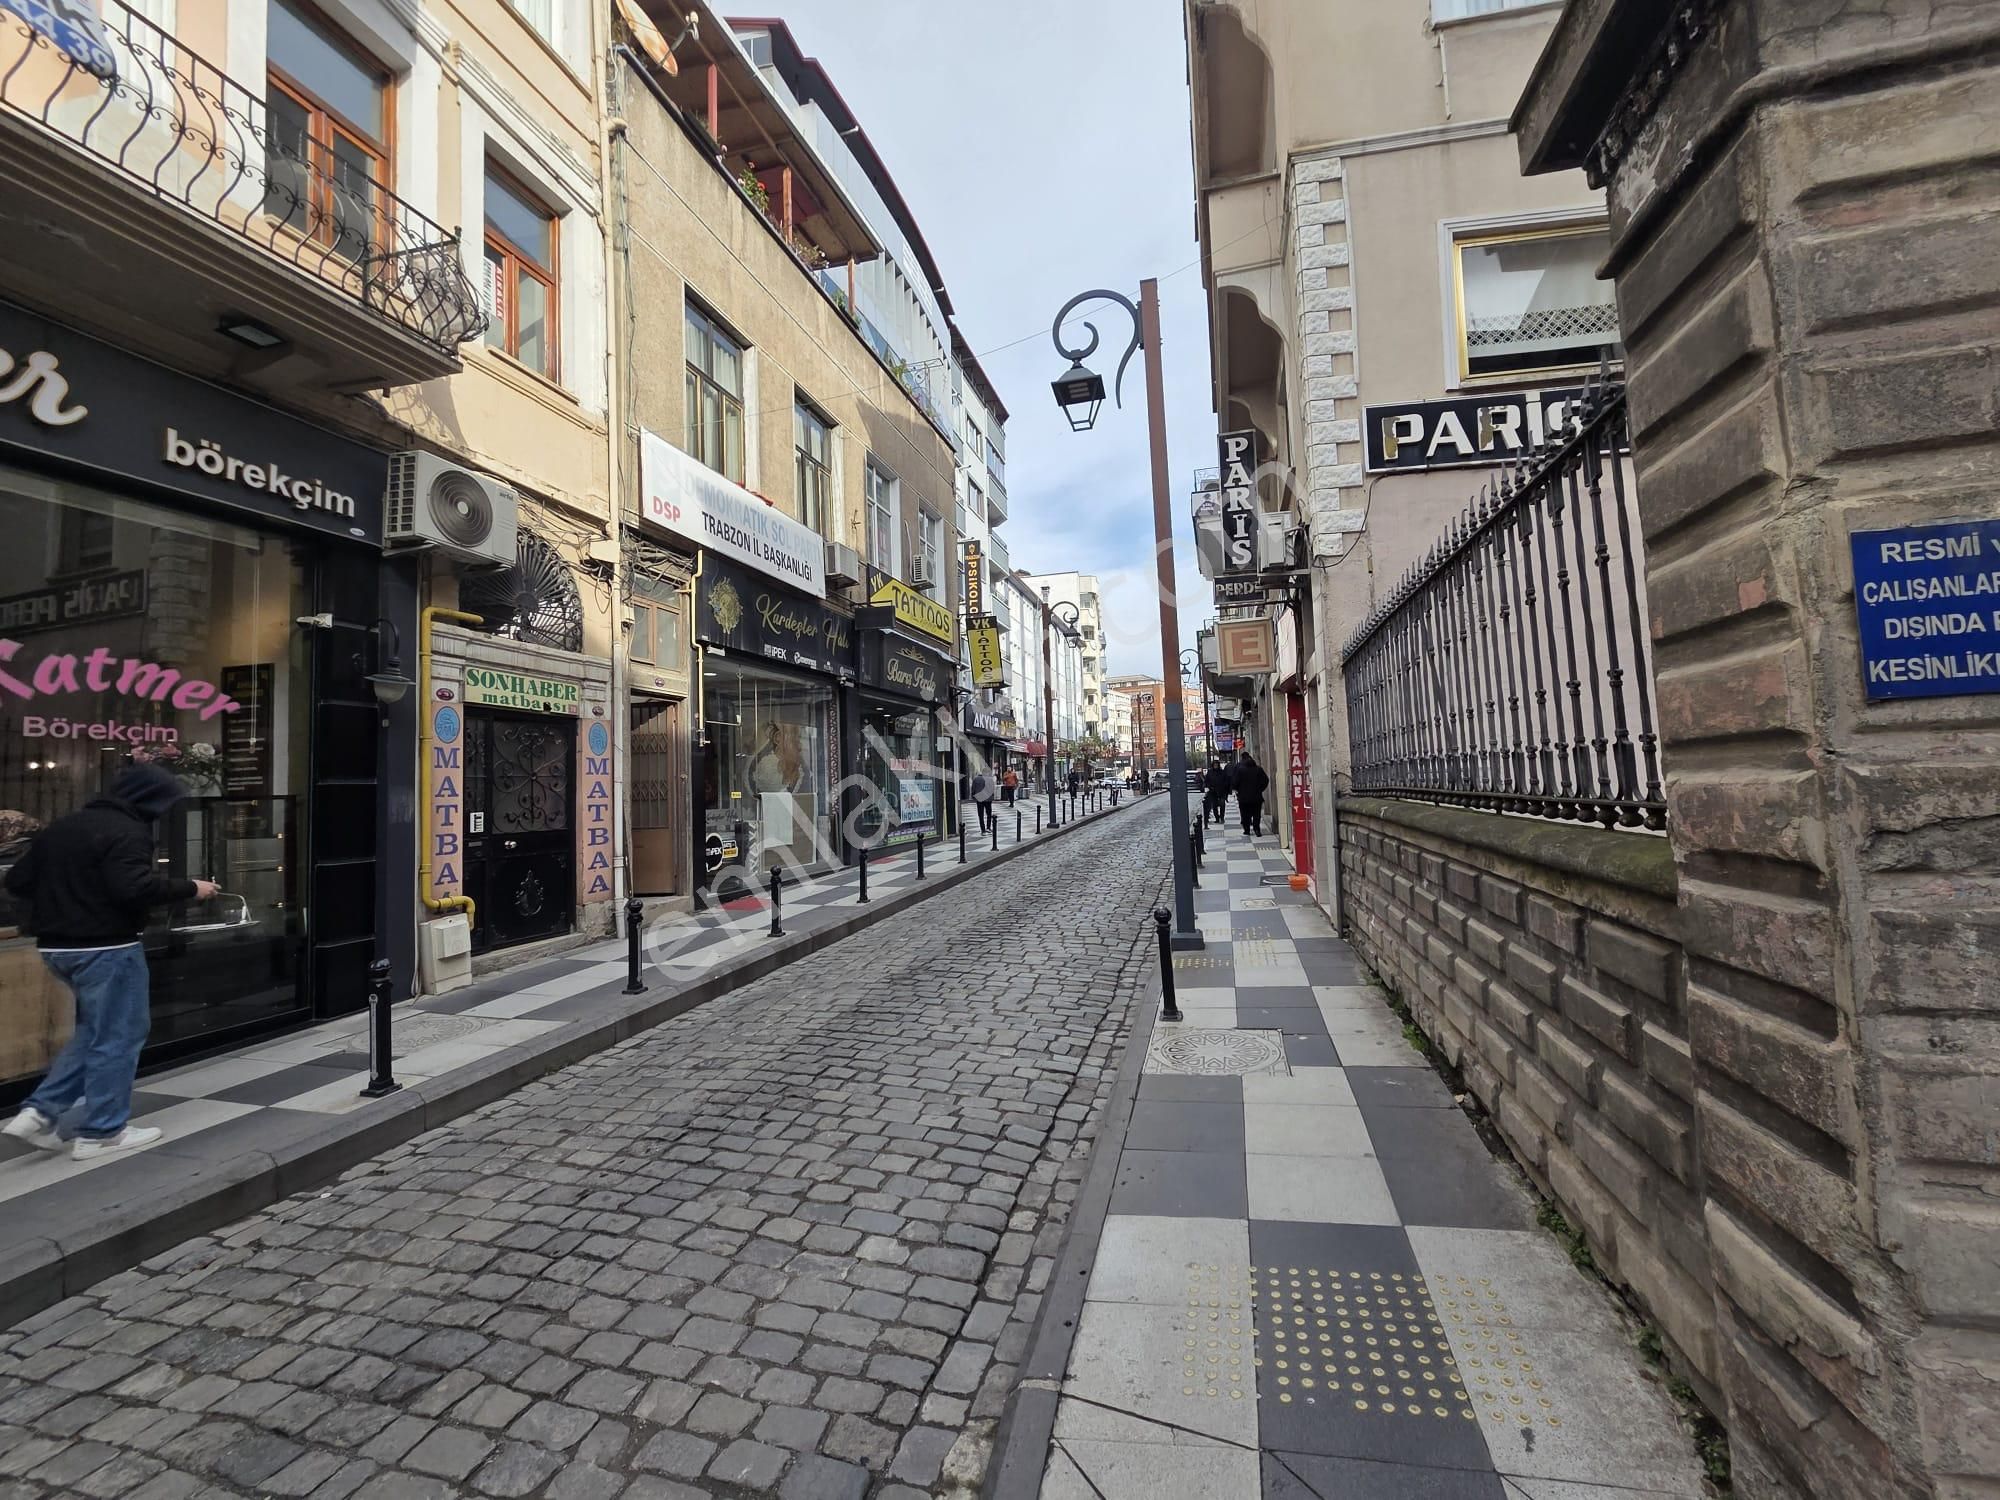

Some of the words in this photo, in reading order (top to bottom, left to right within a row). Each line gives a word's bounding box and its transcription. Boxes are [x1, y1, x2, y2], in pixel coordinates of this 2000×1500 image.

[162, 427, 357, 519] börekçim
[652, 495, 681, 523] DSP
[701, 511, 751, 553] TRABZON
[753, 532, 762, 557] İL
[763, 543, 813, 582] BAŞKANLIĞI
[1880, 532, 1981, 564] RESMİ
[756, 594, 818, 642] Kardeşler
[891, 585, 950, 633] TATTOOS
[973, 618, 990, 628] YK
[1884, 612, 1987, 640] DIŞINDA
[1230, 631, 1262, 665] E
[466, 668, 577, 702] SONHABER
[482, 693, 567, 712] matbası
[23, 716, 179, 746] Börekçim
[434, 747, 461, 897] MATBA
[585, 757, 610, 895] MATBAA
